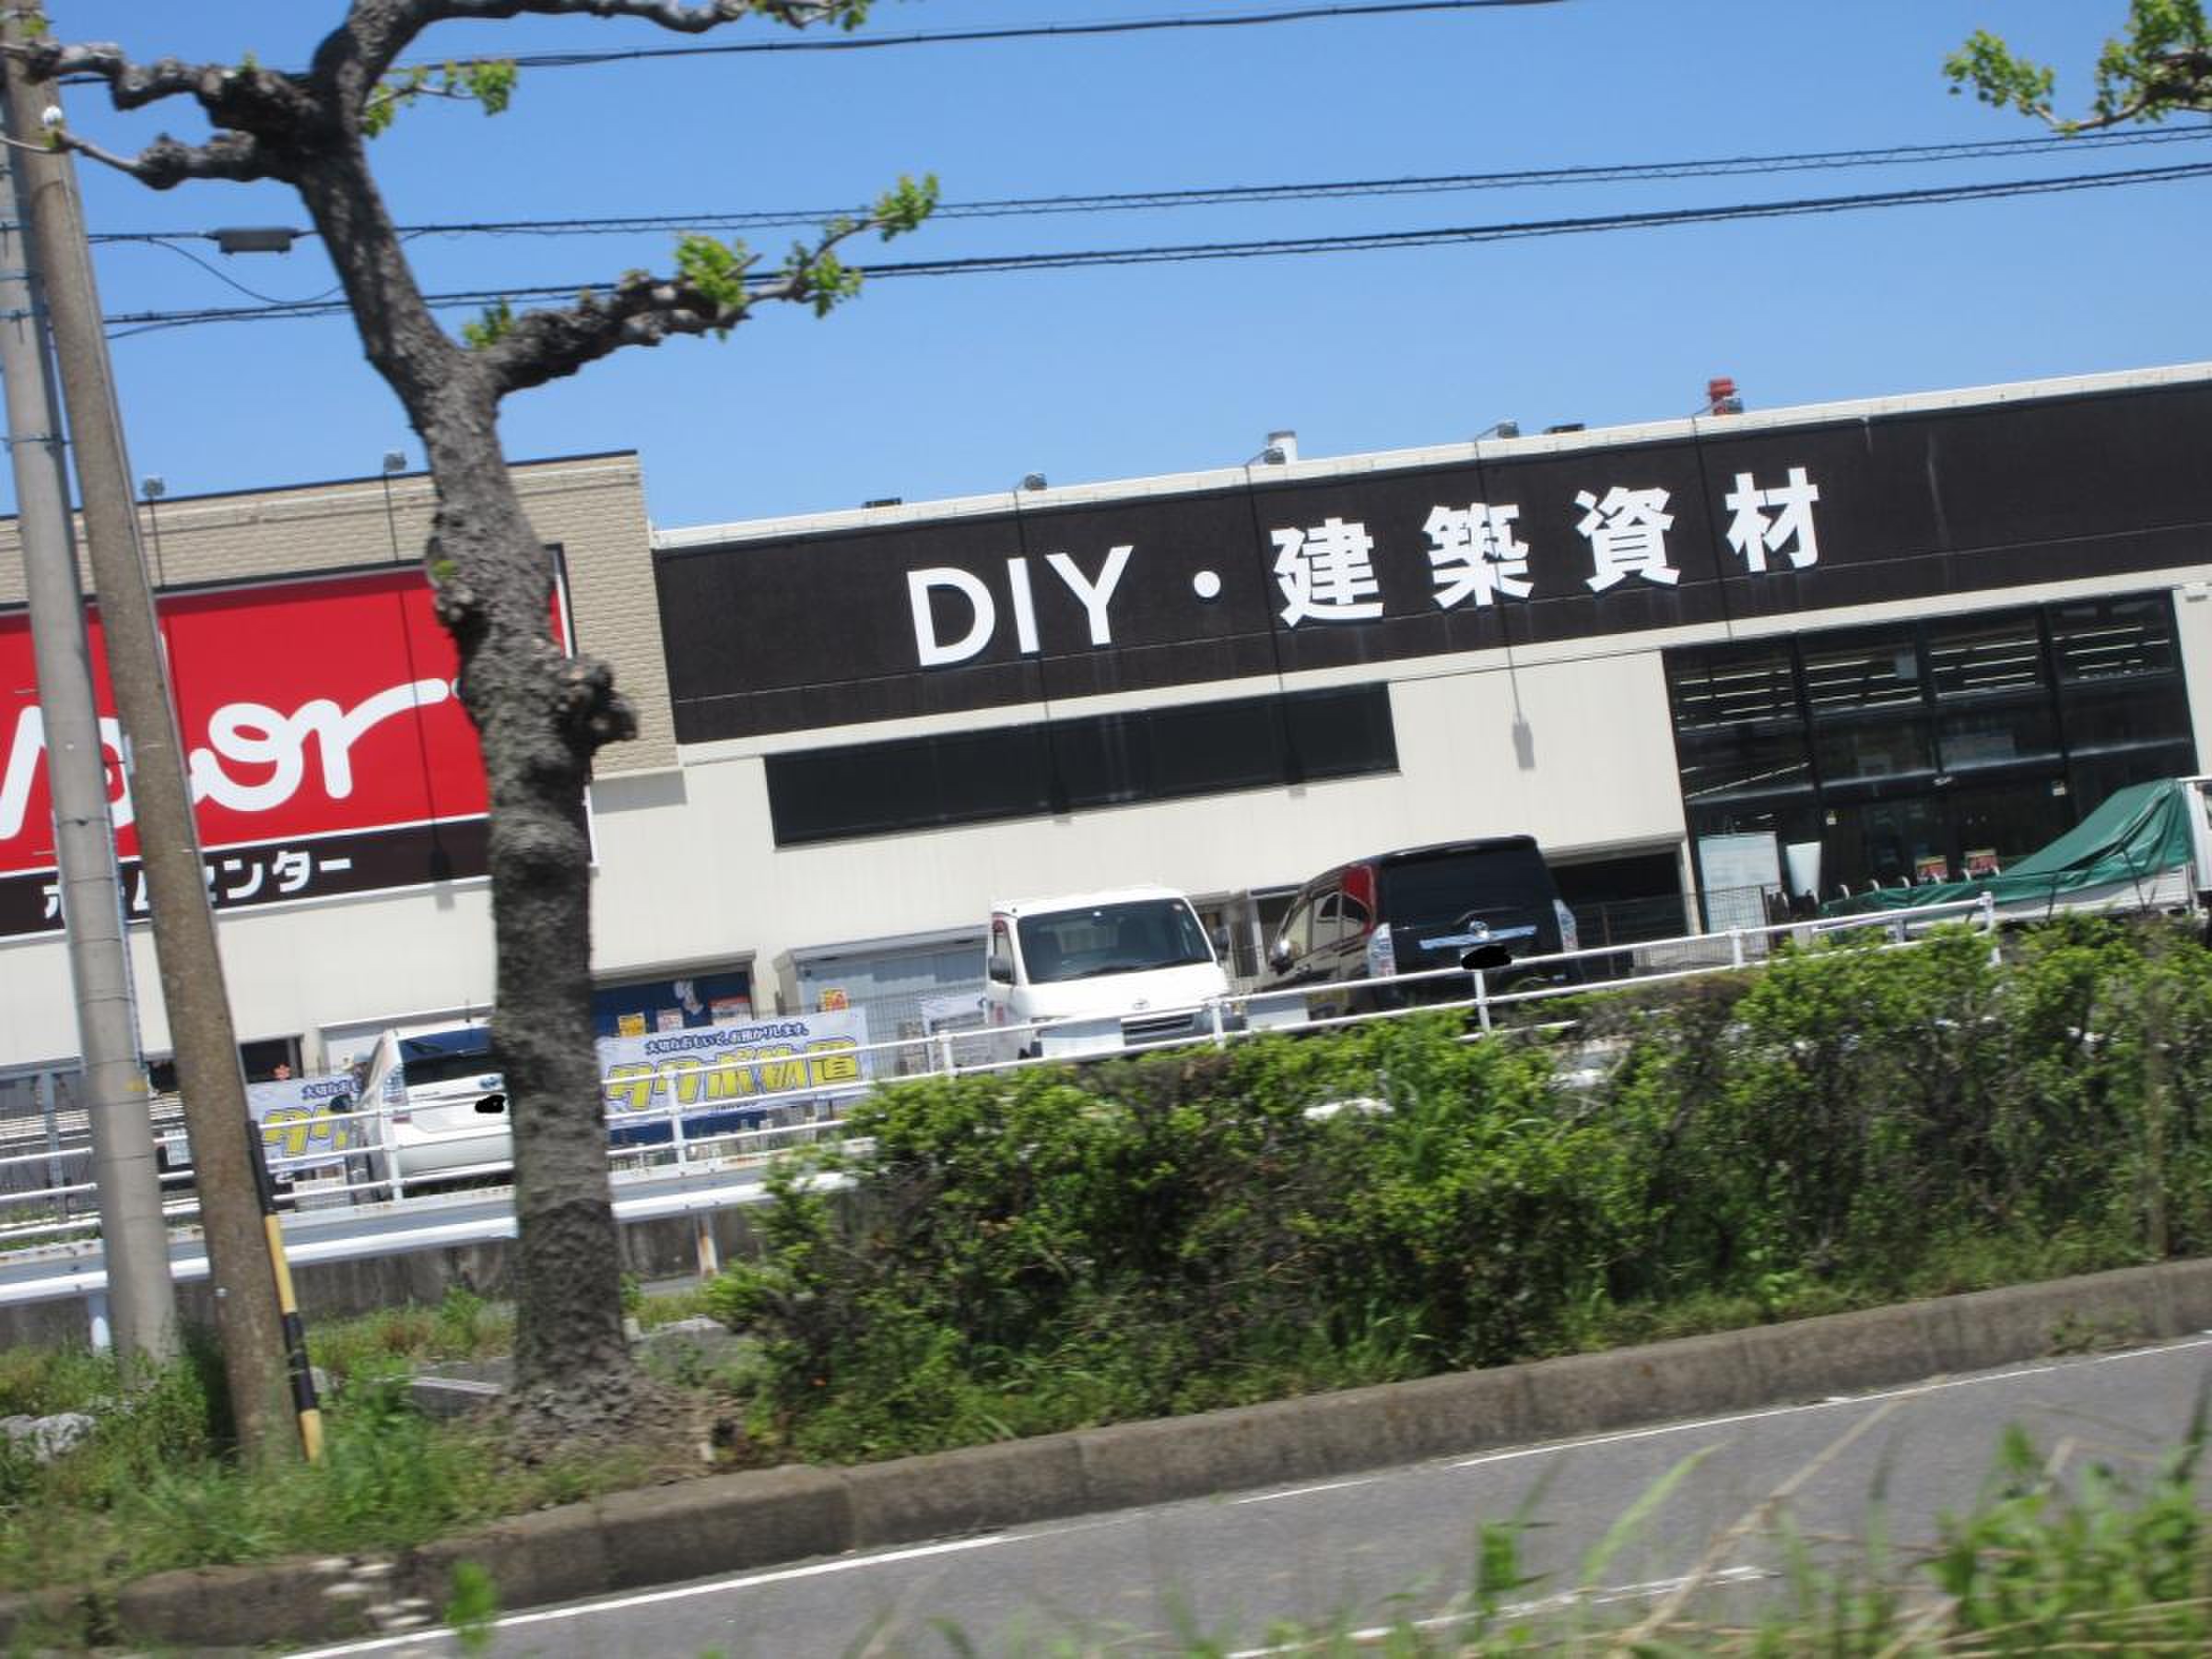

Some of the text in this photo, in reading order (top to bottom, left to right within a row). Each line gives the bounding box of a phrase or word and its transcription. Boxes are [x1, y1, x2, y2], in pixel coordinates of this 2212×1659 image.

[907, 467, 1821, 667] DIY・建築資材
